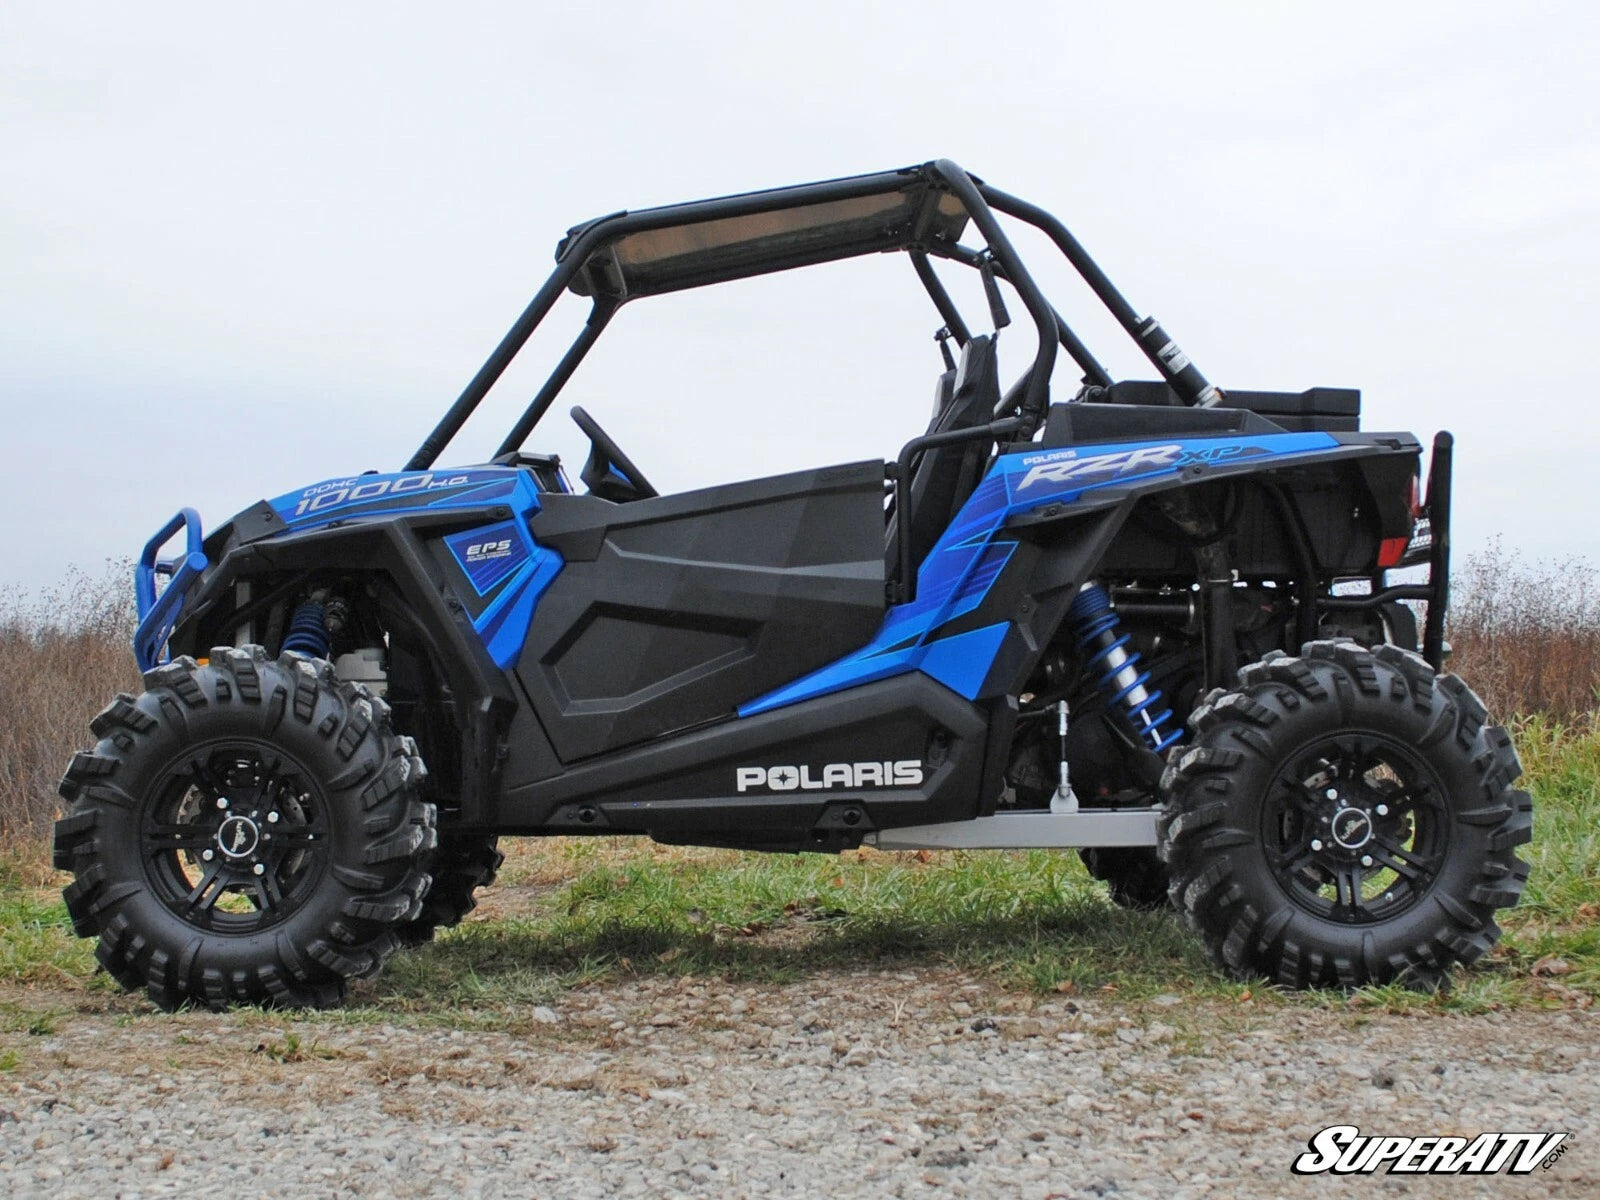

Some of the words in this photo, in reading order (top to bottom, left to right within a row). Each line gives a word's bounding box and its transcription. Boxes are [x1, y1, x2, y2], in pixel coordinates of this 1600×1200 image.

[1016, 445, 1182, 491] RZR
[1171, 446, 1244, 466] XP
[1022, 450, 1078, 466] POLARIS
[295, 474, 434, 516] 1000
[303, 478, 359, 498] DOHC
[466, 539, 511, 556] EPS
[736, 759, 924, 792] POLARIS
